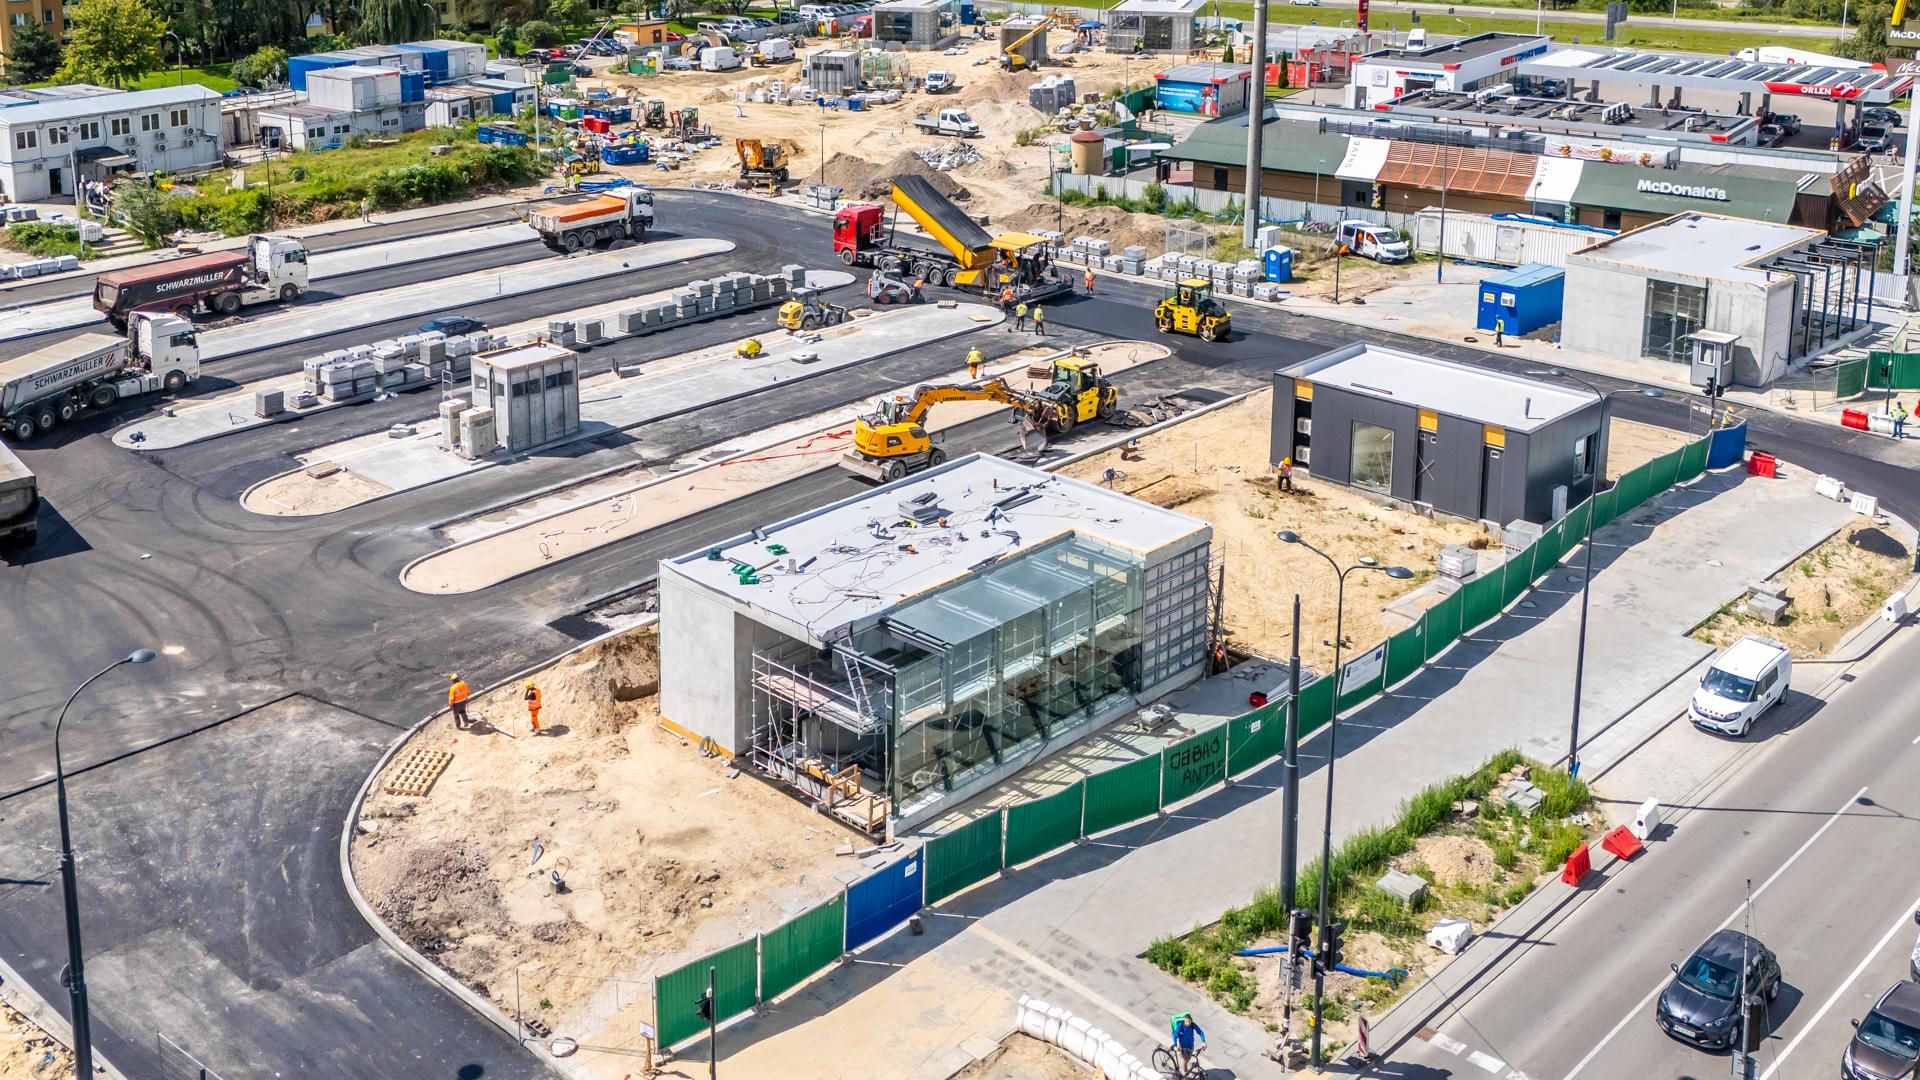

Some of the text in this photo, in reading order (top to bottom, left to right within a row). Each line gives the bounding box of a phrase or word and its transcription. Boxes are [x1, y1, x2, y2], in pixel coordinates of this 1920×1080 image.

[1801, 86, 1832, 95] ORLEN
[1345, 140, 1360, 168] DRIVE
[1636, 179, 1727, 200] McDonald's
[34, 357, 104, 390] SCHWARZMÜLLER
